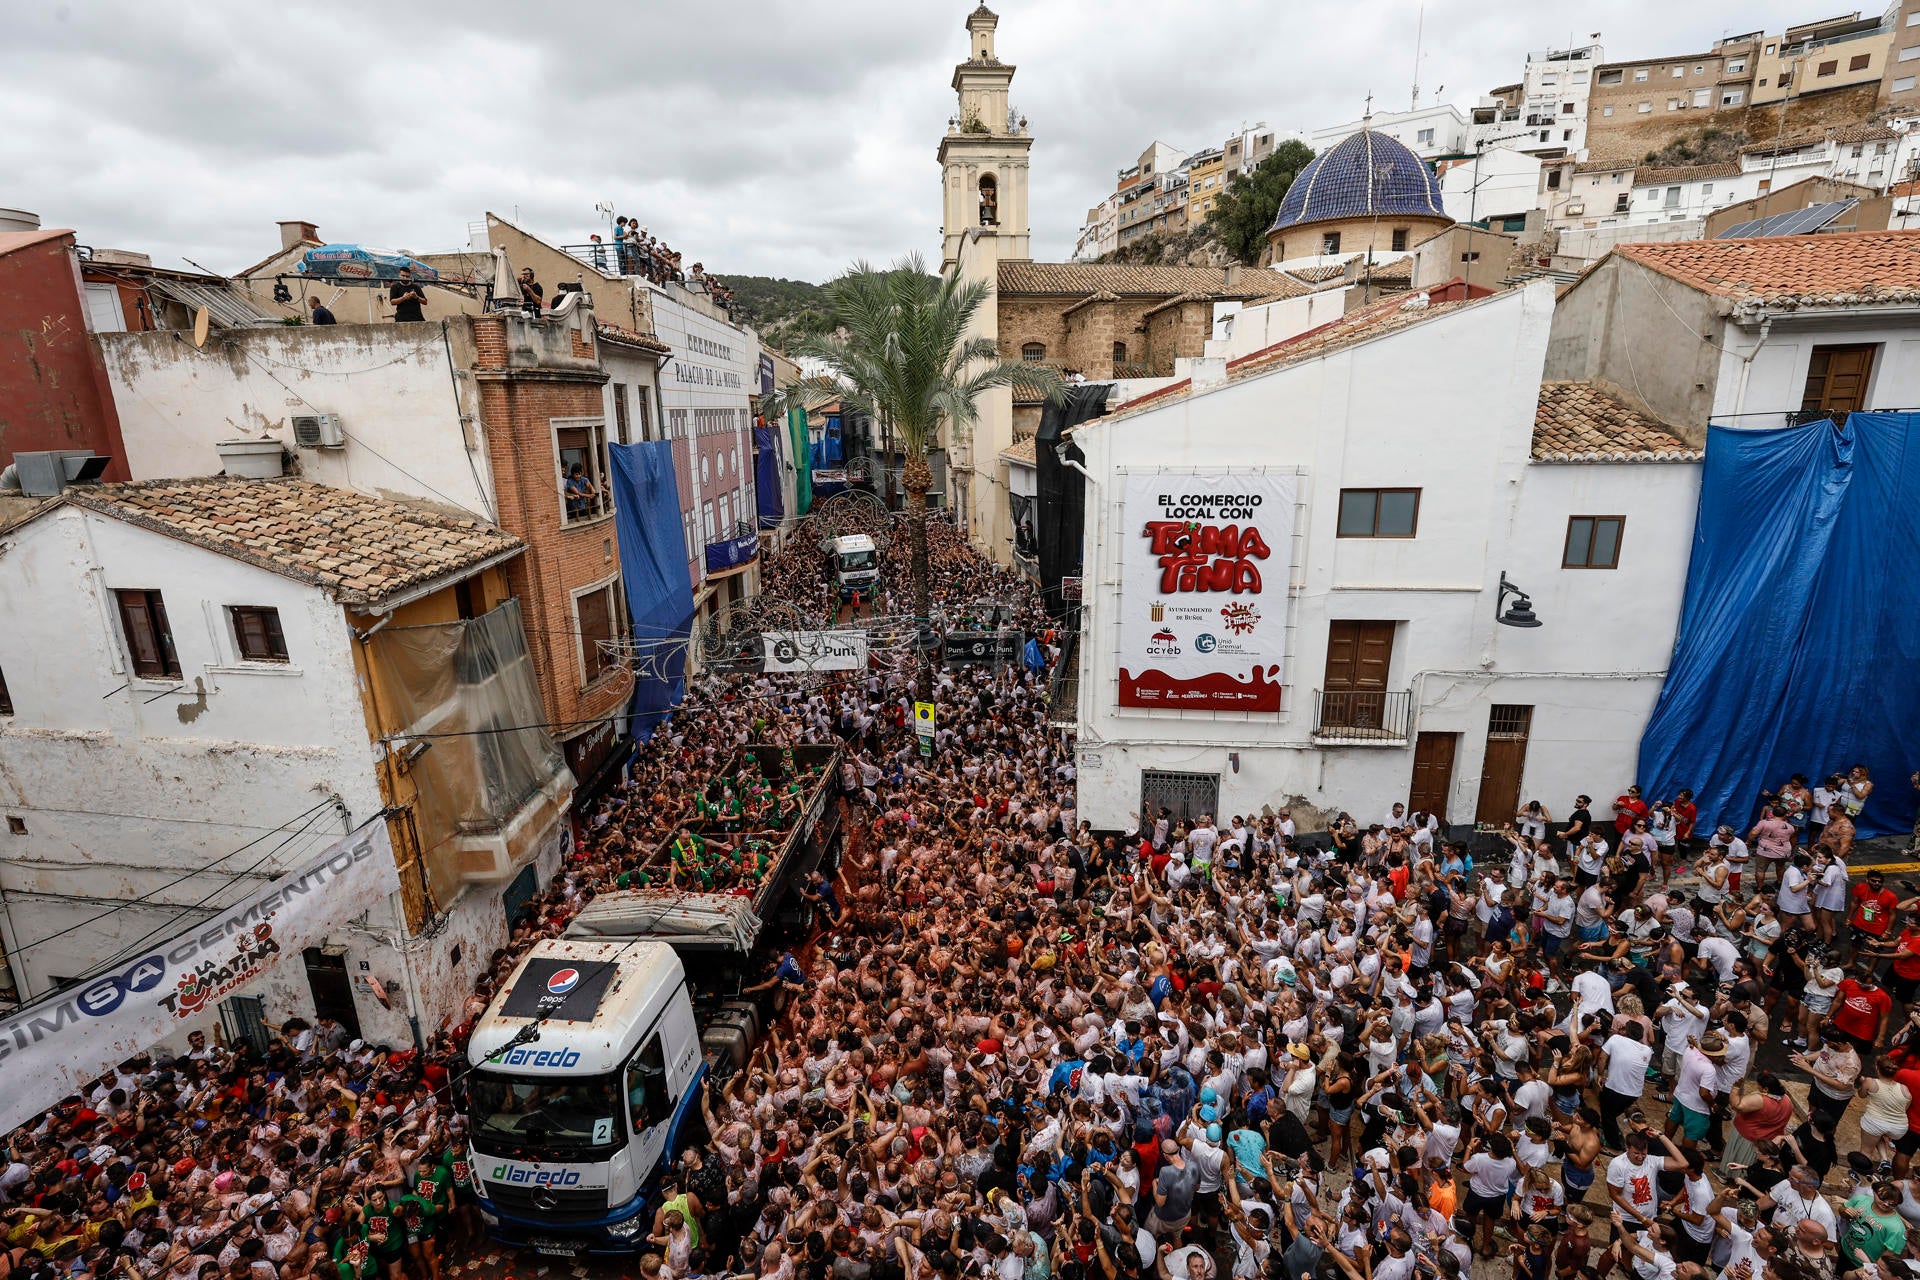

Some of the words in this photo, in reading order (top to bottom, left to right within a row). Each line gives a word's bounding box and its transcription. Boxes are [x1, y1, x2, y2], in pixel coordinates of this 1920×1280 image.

[675, 362, 703, 384] PALACIO
[706, 368, 714, 386] DE
[715, 370, 722, 387] LA
[1158, 495, 1176, 506] EL
[1180, 495, 1262, 507] COMERCIO
[1166, 508, 1214, 519] LOCAL
[1219, 508, 1253, 520] CON
[1143, 521, 1270, 559] TOMA
[825, 646, 856, 657] Punt
[1217, 643, 1242, 651] Gremial
[167, 840, 373, 966] CEMENTOS
[195, 960, 216, 976] LA
[361, 961, 369, 970] 2
[208, 993, 219, 1002] de
[219, 966, 261, 996] BUÑOL
[597, 1124, 607, 1140] 2
[492, 1164, 580, 1185] dlaredo
